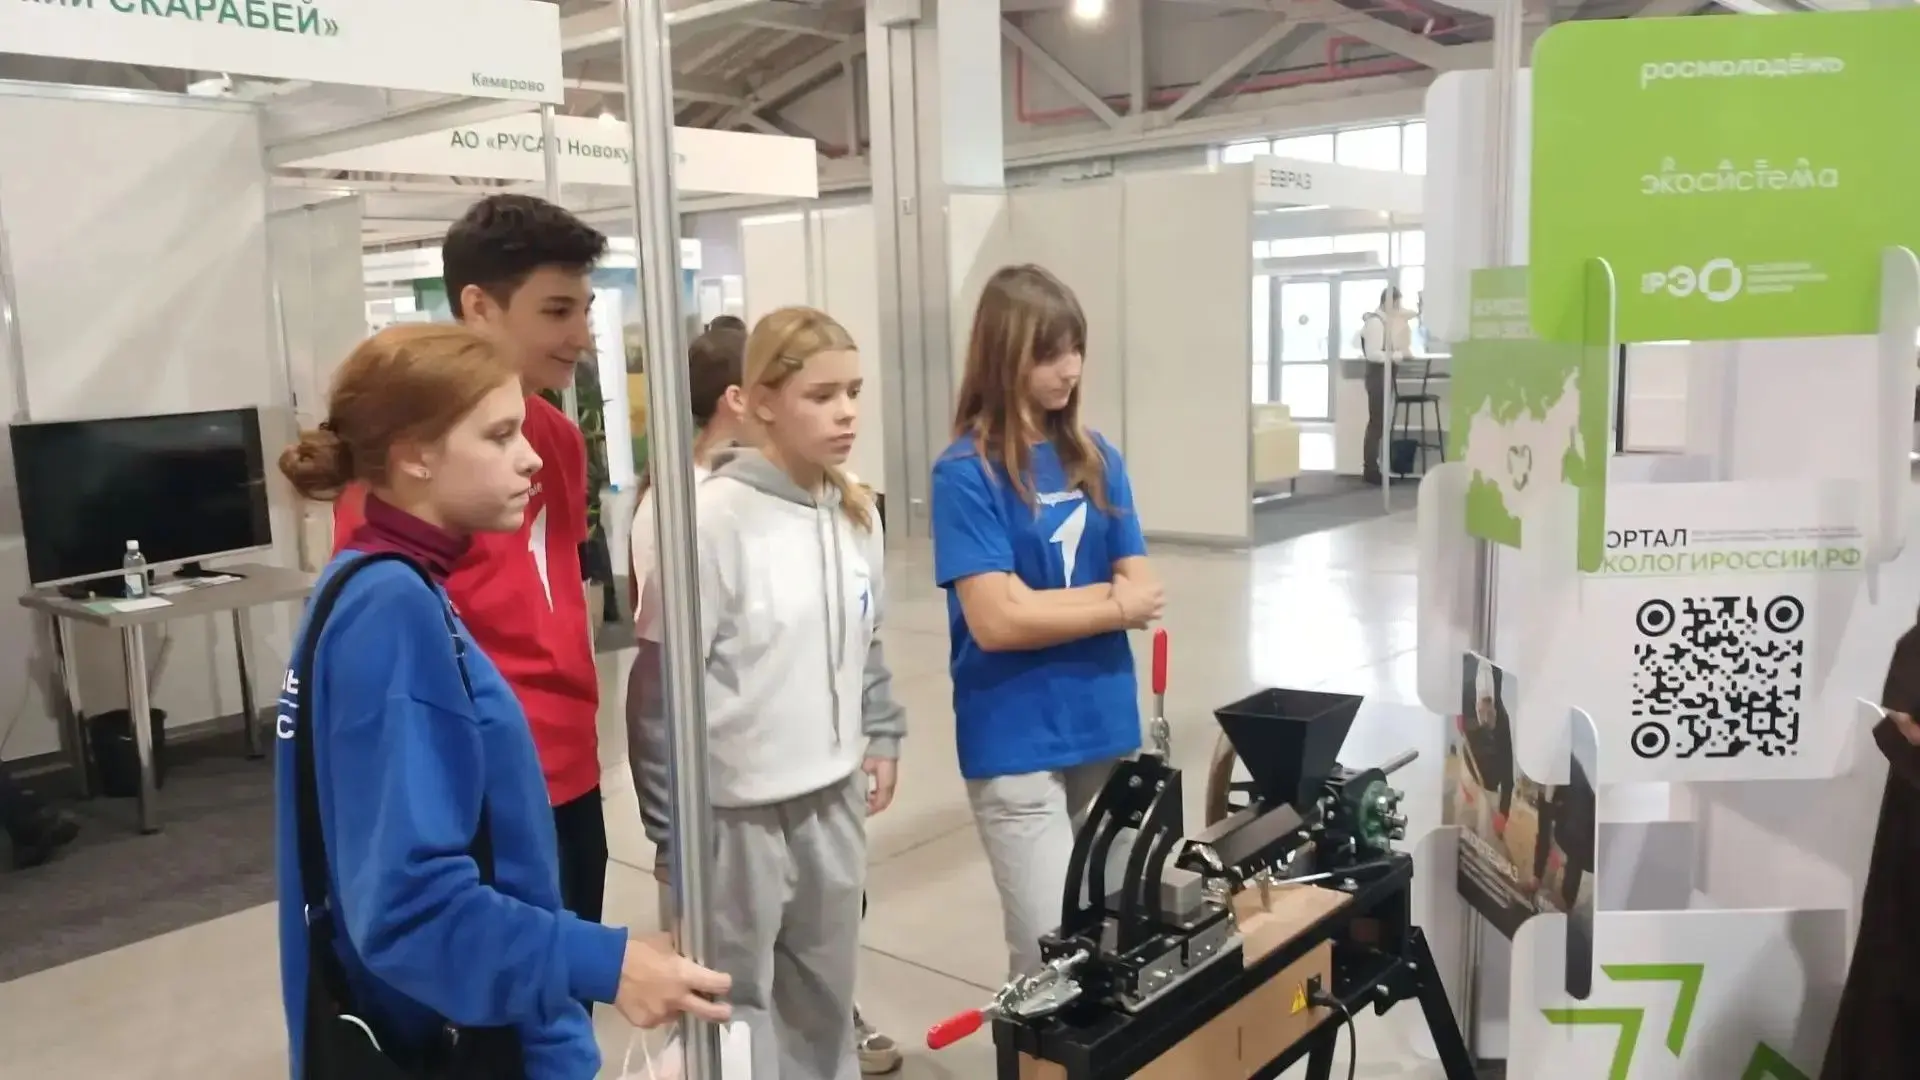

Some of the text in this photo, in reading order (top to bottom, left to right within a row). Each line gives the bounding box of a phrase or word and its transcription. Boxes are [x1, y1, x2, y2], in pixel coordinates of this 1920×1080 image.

[451, 130, 480, 149] АО
[1270, 168, 1312, 190] ЕВРАЗ
[1606, 528, 1688, 549] ОРТАЛ
[1602, 547, 1861, 574] КОЛОГИРОССИИ.РФ
